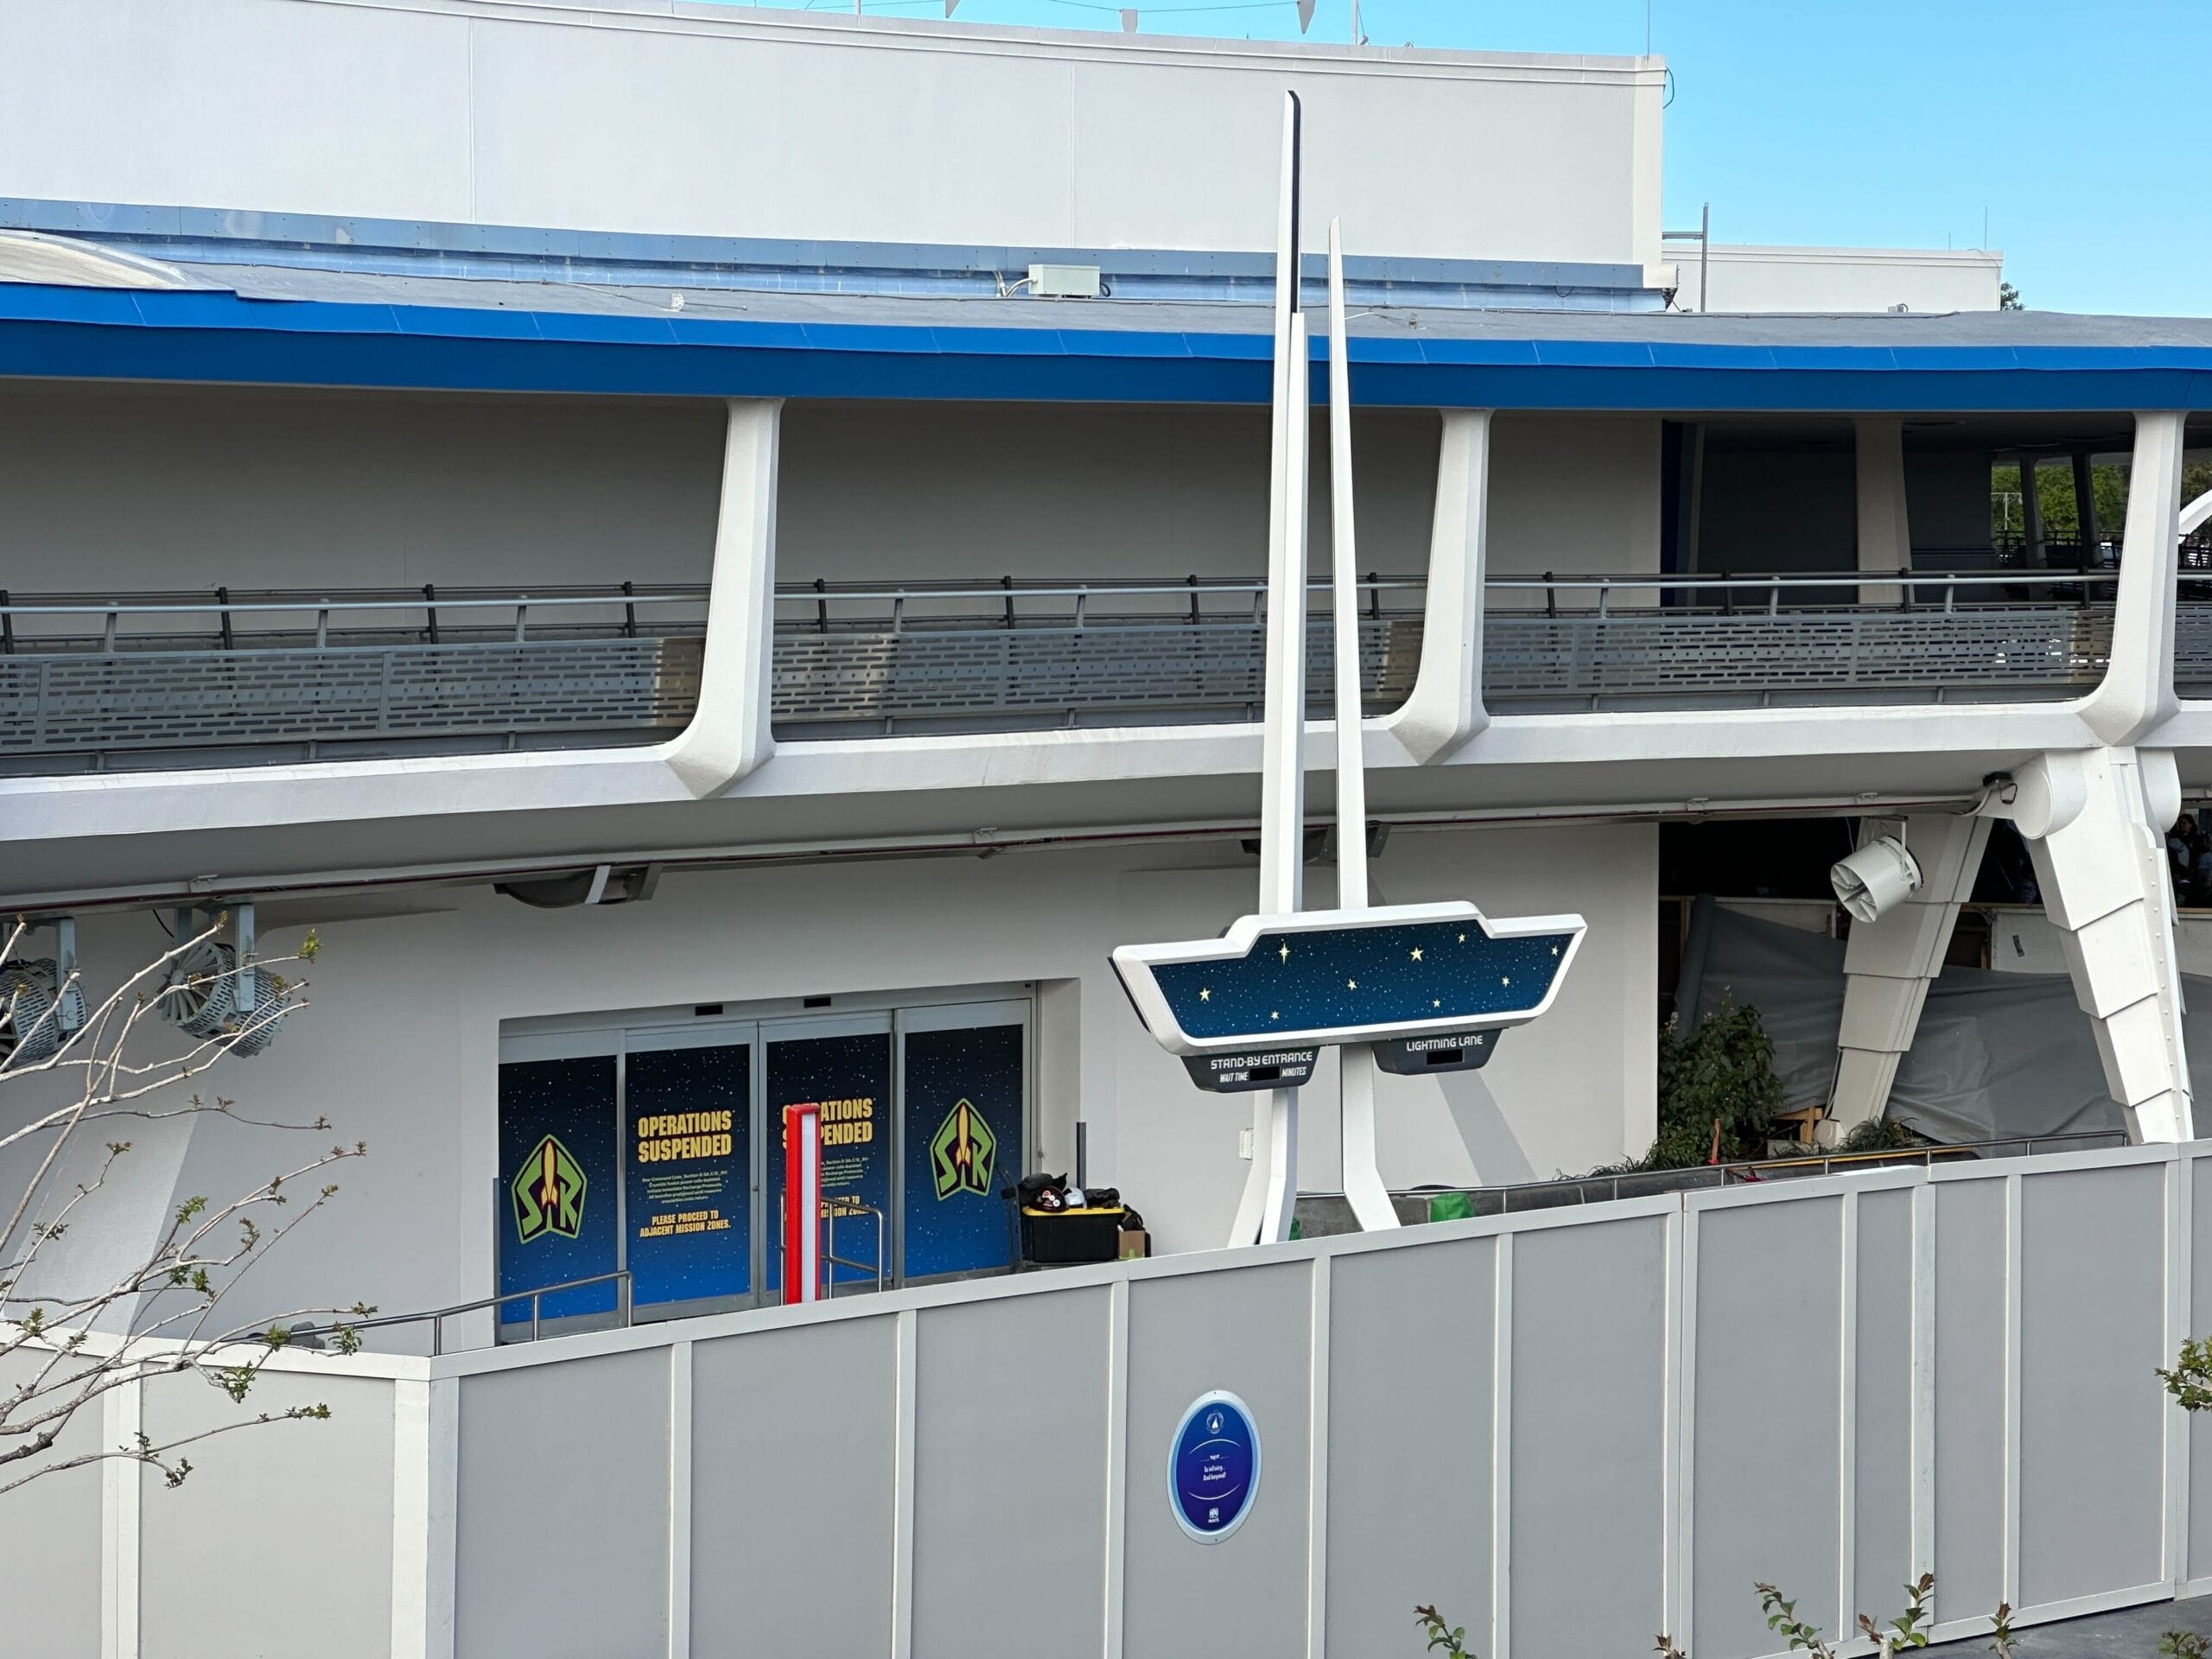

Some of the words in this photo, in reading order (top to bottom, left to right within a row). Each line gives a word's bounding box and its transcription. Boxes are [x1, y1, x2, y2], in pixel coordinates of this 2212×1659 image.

[1406, 1037, 1457, 1052] LIGHTNING
[1459, 1035, 1484, 1046] LANE
[1211, 1055, 1262, 1070] STAND-BY
[1262, 1051, 1313, 1065] ENTRANCE
[1219, 1072, 1234, 1083] WAIT
[1235, 1071, 1249, 1082] TIME
[1281, 1066, 1307, 1077] MINUTES
[782, 1097, 873, 1125] ATIONS
[638, 1109, 732, 1138] OPERATIONS
[782, 1121, 873, 1149] ENDED
[638, 1134, 732, 1163] SUSPENDED
[652, 1214, 676, 1225] PLEASE
[678, 1211, 708, 1223] PROCEED
[710, 1210, 719, 1219] TO
[639, 1225, 674, 1237] ADJACENT
[676, 1221, 705, 1234] MISSION
[707, 1219, 731, 1230] ZONES.
